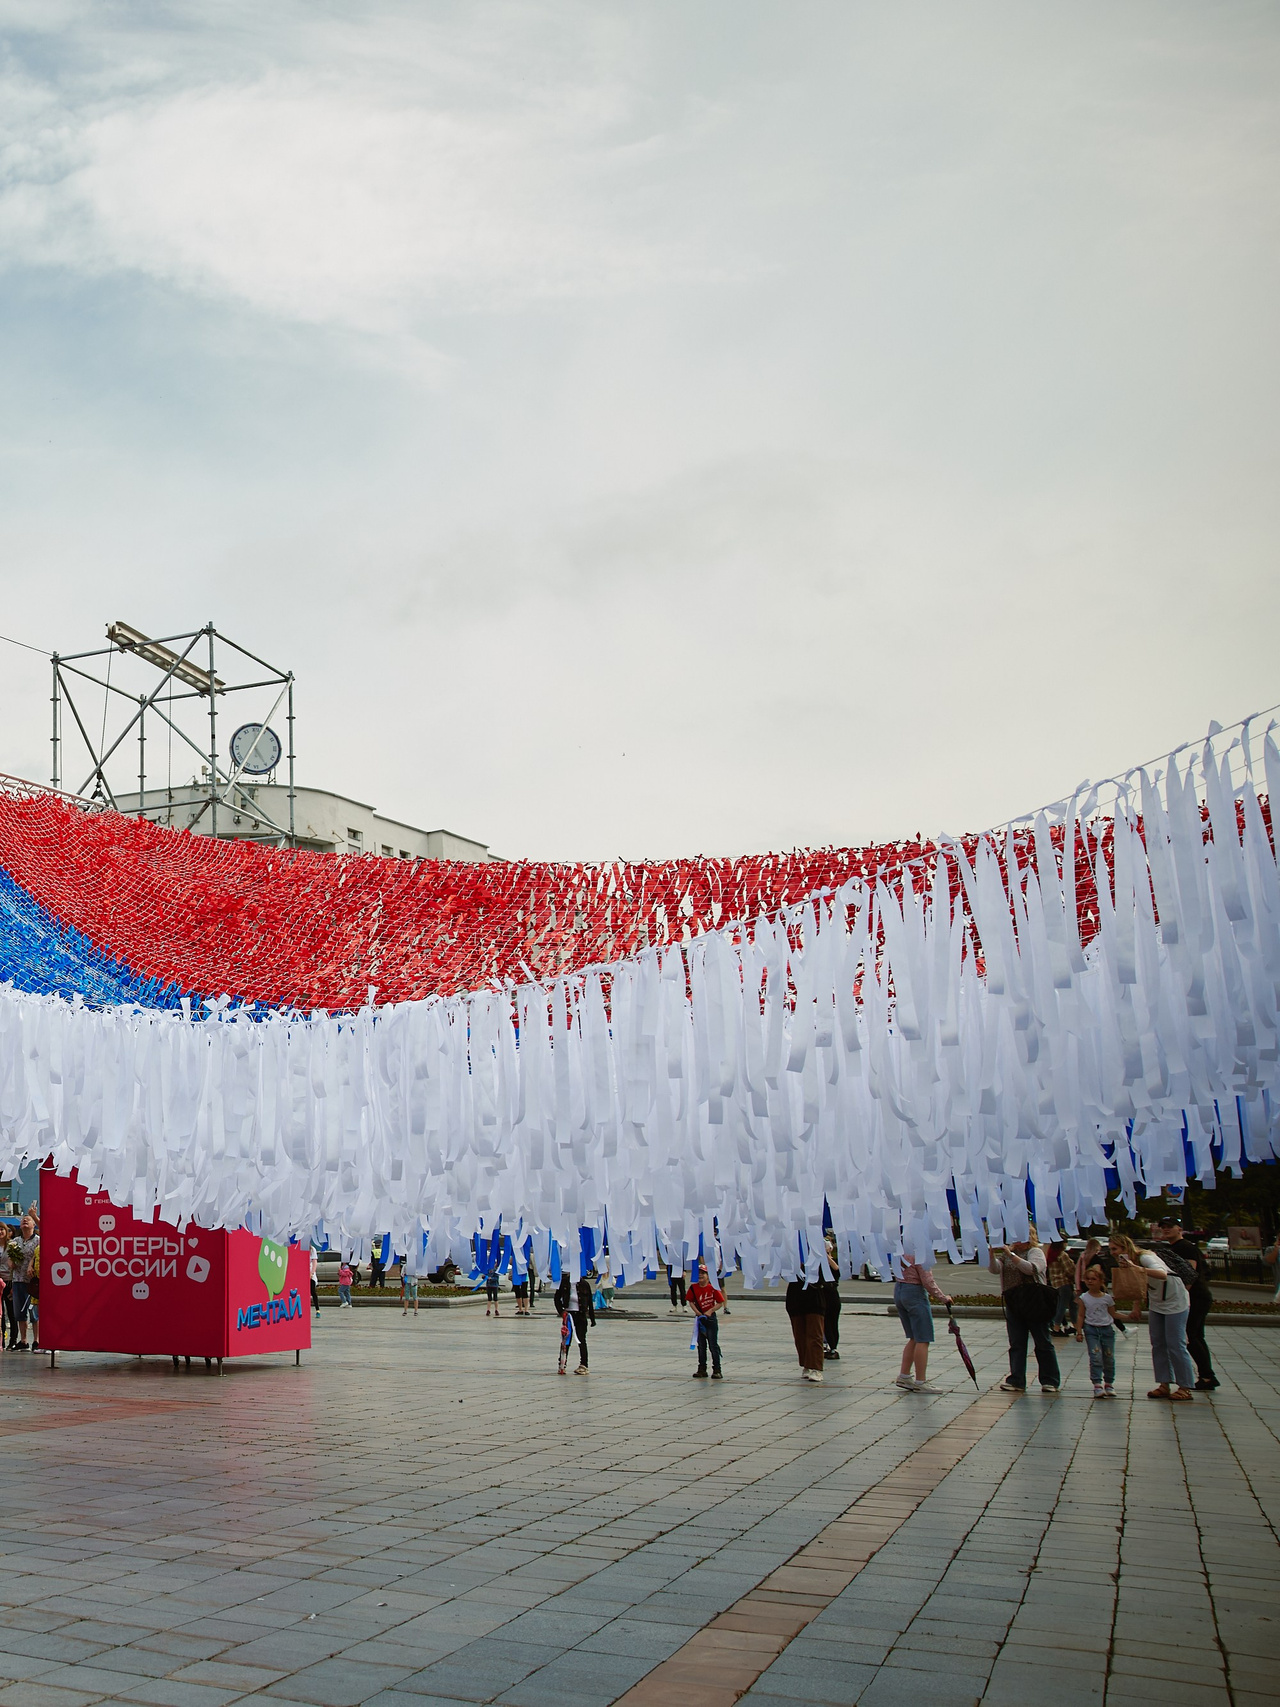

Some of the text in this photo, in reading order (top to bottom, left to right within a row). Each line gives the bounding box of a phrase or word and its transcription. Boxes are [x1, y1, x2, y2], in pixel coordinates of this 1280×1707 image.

[73, 1236, 185, 1256] БЛОГЕРЫ
[79, 1258, 177, 1278] РОССИИ
[236, 1288, 303, 1331] МЕЧТАЙ
